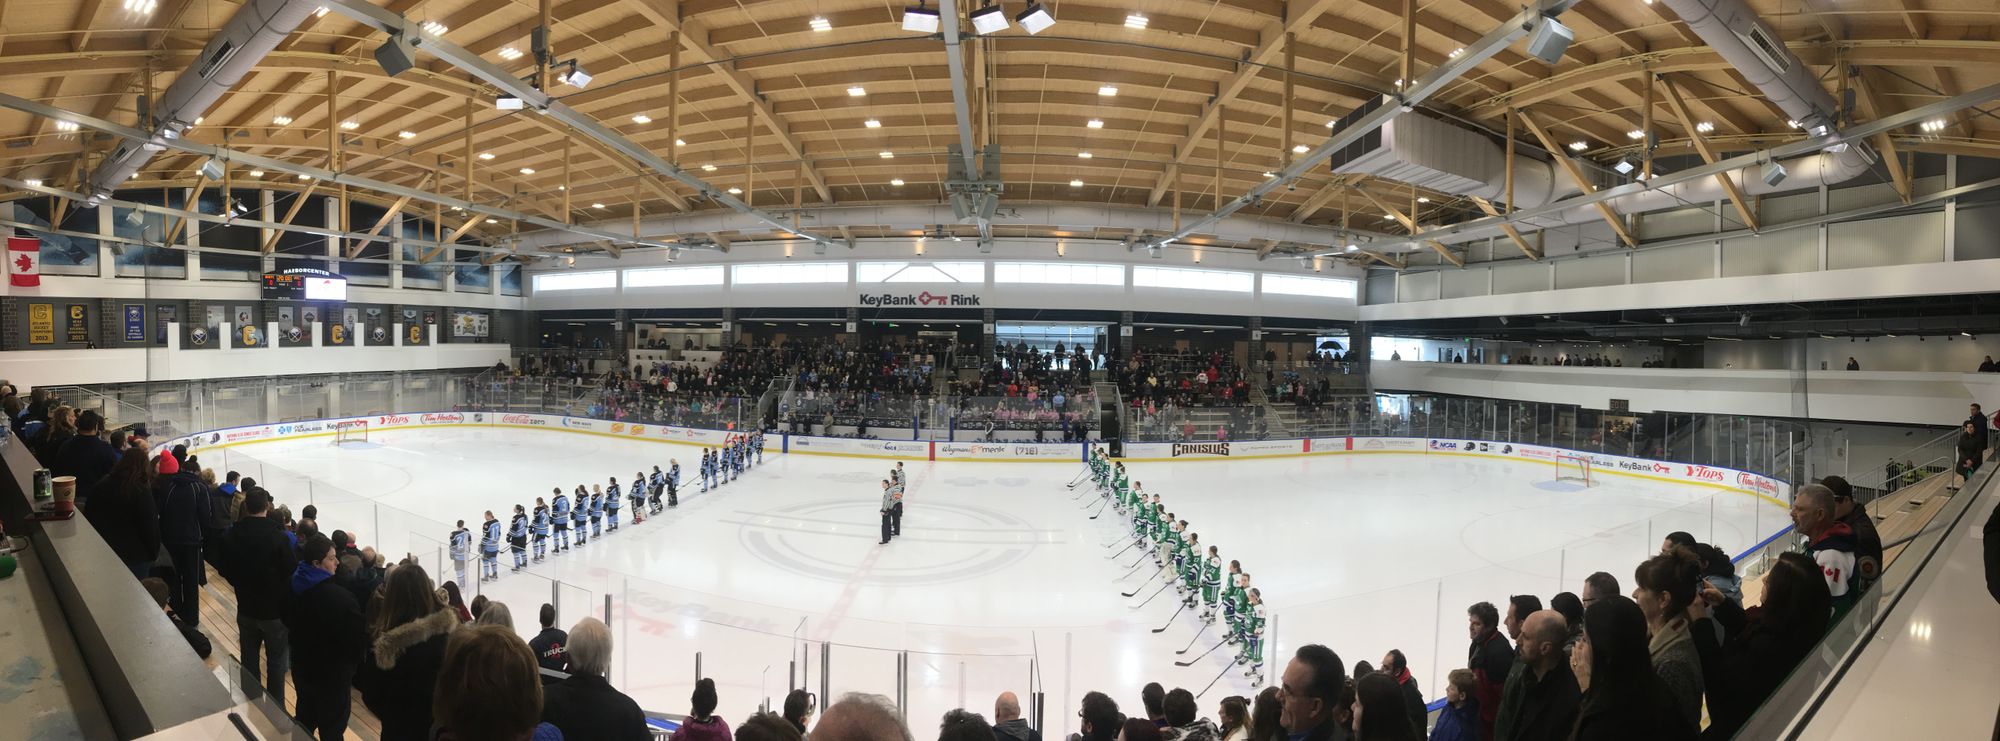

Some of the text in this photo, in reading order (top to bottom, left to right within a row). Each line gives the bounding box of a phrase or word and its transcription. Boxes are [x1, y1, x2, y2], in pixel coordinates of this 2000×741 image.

[284, 268, 330, 276] HARBORCENTER
[860, 294, 980, 306] KeyBank Rink
[1172, 442, 1230, 457] CANISIUS
[1620, 460, 1652, 472] KeyBank
